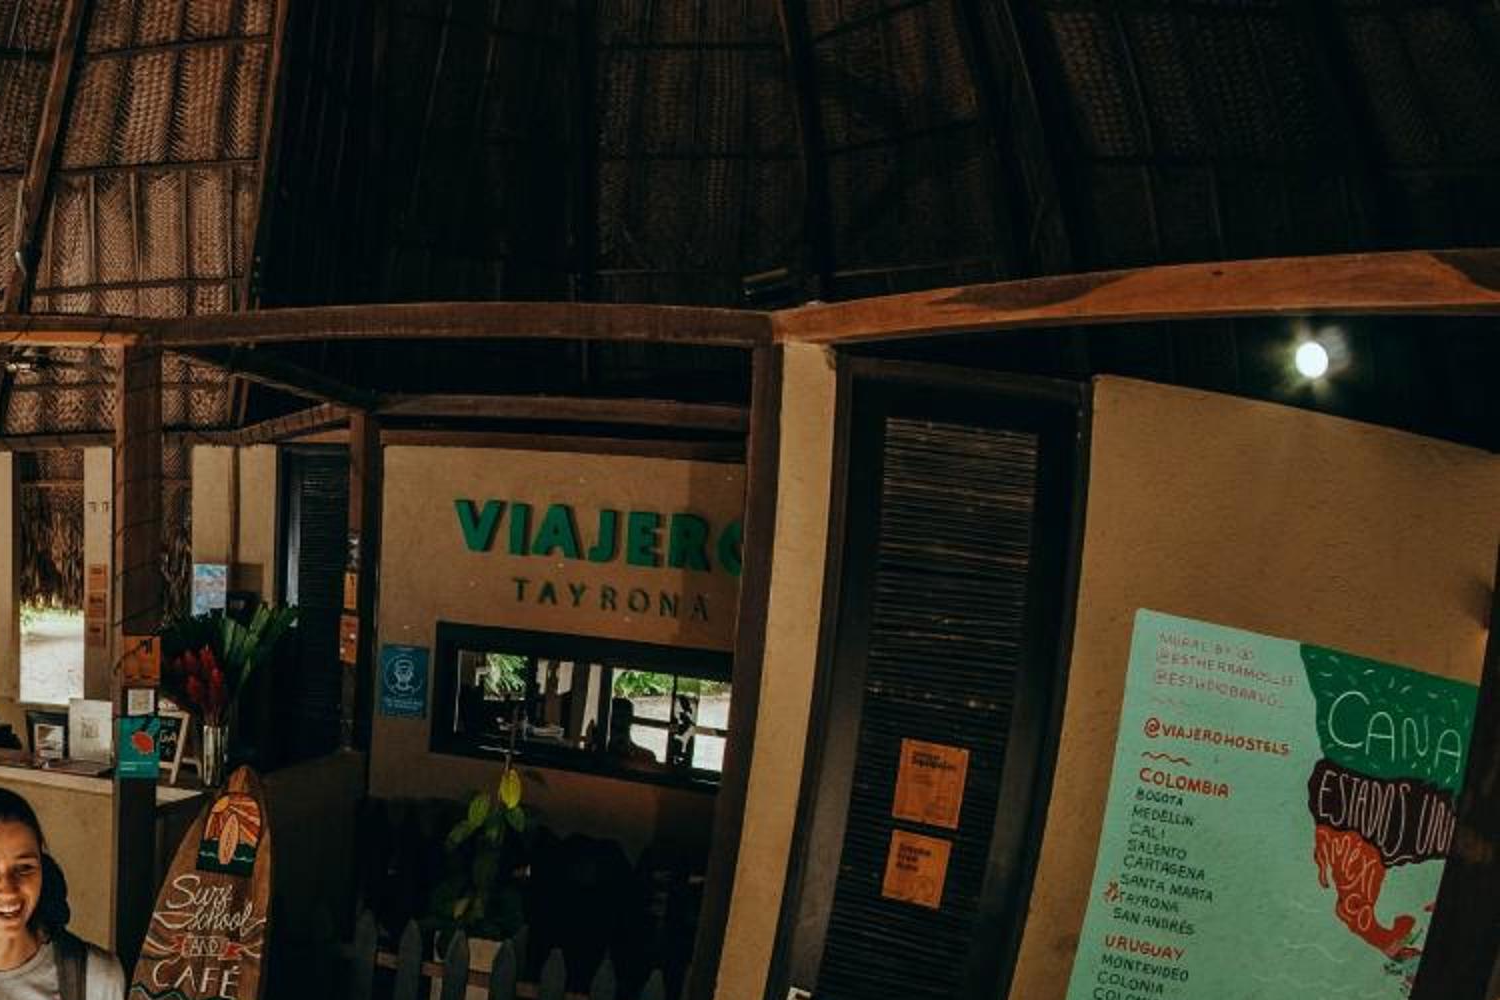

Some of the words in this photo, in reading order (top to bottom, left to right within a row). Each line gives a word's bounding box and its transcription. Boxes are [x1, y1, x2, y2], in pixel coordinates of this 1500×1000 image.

[512, 576, 709, 622] TAYRONA
[1144, 717, 1291, 756] @VIAJEROHOSTELS
[1328, 691, 1461, 774] CANA
[1136, 786, 1184, 807] BOGOTA
[1139, 767, 1230, 798] COLOMBIA
[1319, 769, 1411, 857] ESTADOS
[1416, 794, 1456, 855] UNI
[1129, 822, 1166, 842] CALI
[1127, 838, 1188, 861] SALENTO
[1123, 854, 1206, 881] CARTAGENA
[165, 874, 234, 912] Surf
[1119, 872, 1165, 892] SANTA
[1169, 883, 1214, 902] MARTA
[1119, 890, 1180, 913] TAYRONA
[1112, 906, 1141, 926] SAN
[189, 938, 219, 955] AND
[1105, 934, 1185, 961] URUGUAY
[153, 956, 242, 1000] CAFÉ
[1101, 953, 1190, 983] MONTEVIDEO
[1097, 970, 1165, 995] COLONIA
